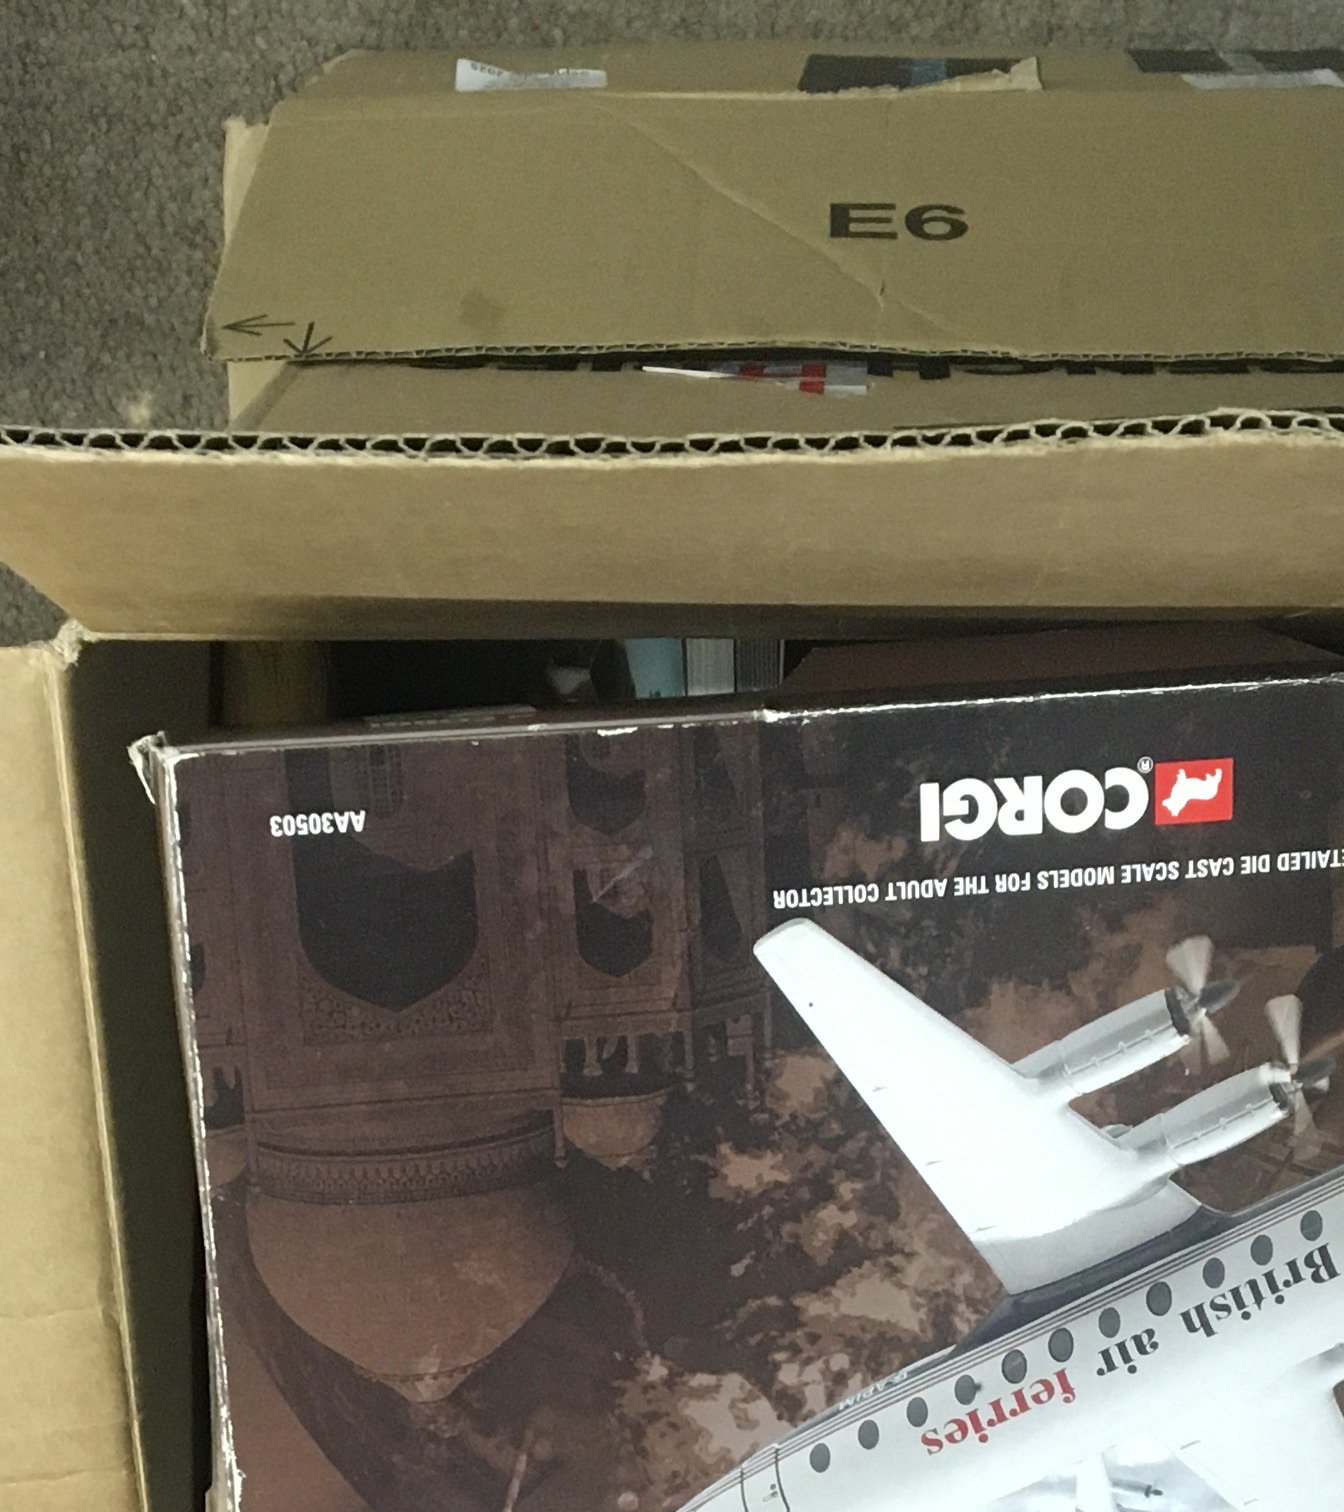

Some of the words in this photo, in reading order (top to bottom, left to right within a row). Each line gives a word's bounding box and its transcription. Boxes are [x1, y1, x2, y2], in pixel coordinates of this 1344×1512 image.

[828, 203, 970, 241] E6
[919, 766, 1150, 842] CORGI
[269, 809, 366, 838] AA30503
[1037, 864, 1115, 890] MODELS
[1120, 860, 1180, 884] SCALE
[1184, 856, 1235, 879] CAST
[1240, 853, 1270, 875] DIE
[885, 878, 948, 901] ADULT
[953, 875, 990, 897] THE
[995, 871, 1031, 893] FOR
[772, 882, 880, 909] COLLECTOR
[1178, 1241, 1342, 1338] British
[1096, 1326, 1159, 1377] air
[920, 1368, 1077, 1456] ferries
